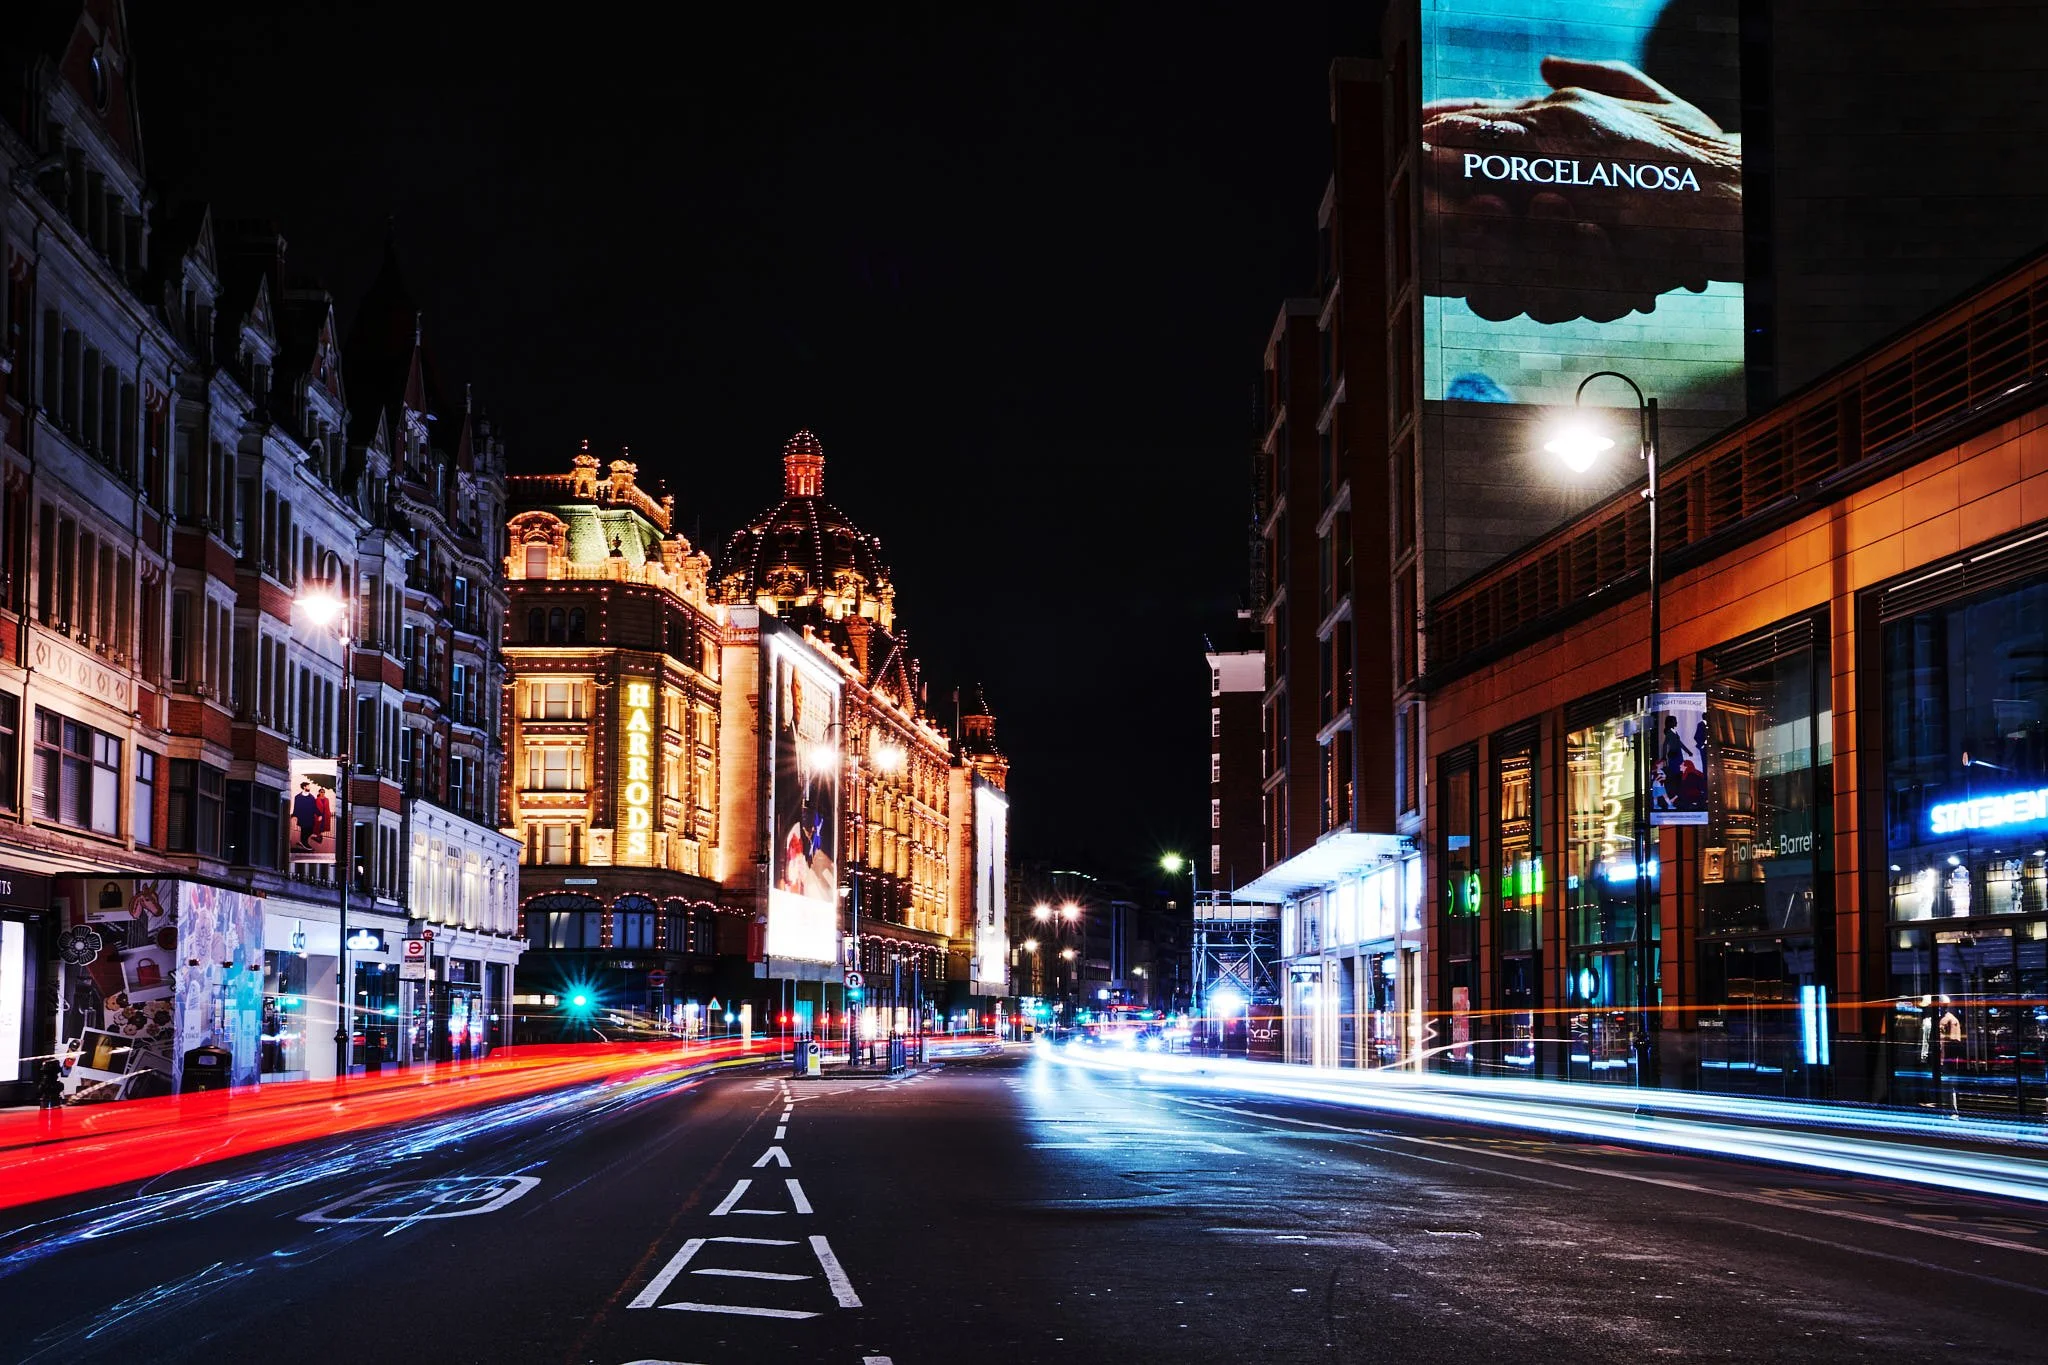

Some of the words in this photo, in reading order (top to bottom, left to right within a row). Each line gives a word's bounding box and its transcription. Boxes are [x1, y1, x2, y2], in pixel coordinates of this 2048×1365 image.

[1464, 153, 1700, 191] PORCELANOSA
[625, 682, 651, 857] HARRODS
[0, 880, 11, 895] TS
[1249, 1029, 1279, 1039] YDF
